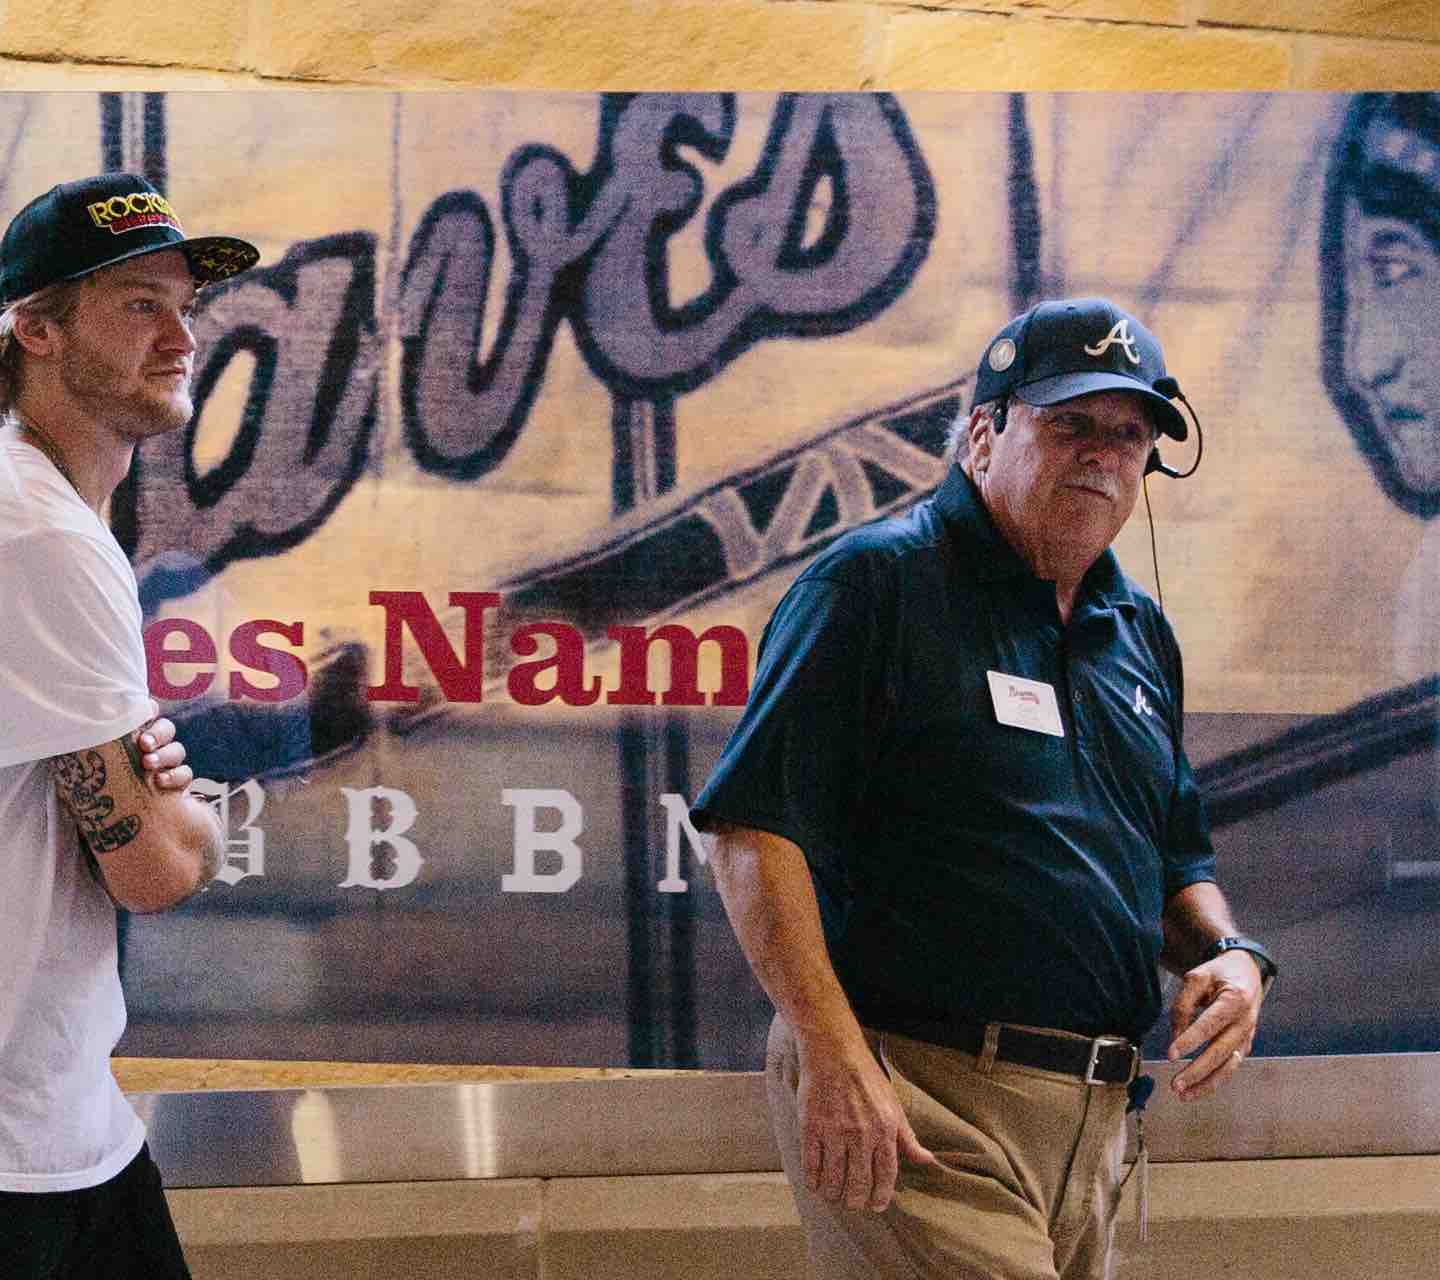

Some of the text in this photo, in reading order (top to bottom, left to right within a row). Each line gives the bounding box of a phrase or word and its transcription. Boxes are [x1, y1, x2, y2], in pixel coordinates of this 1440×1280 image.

[1083, 319, 1141, 365] A
[367, 591, 750, 707] Nam
[337, 785, 425, 890] B
[500, 788, 583, 894] B
